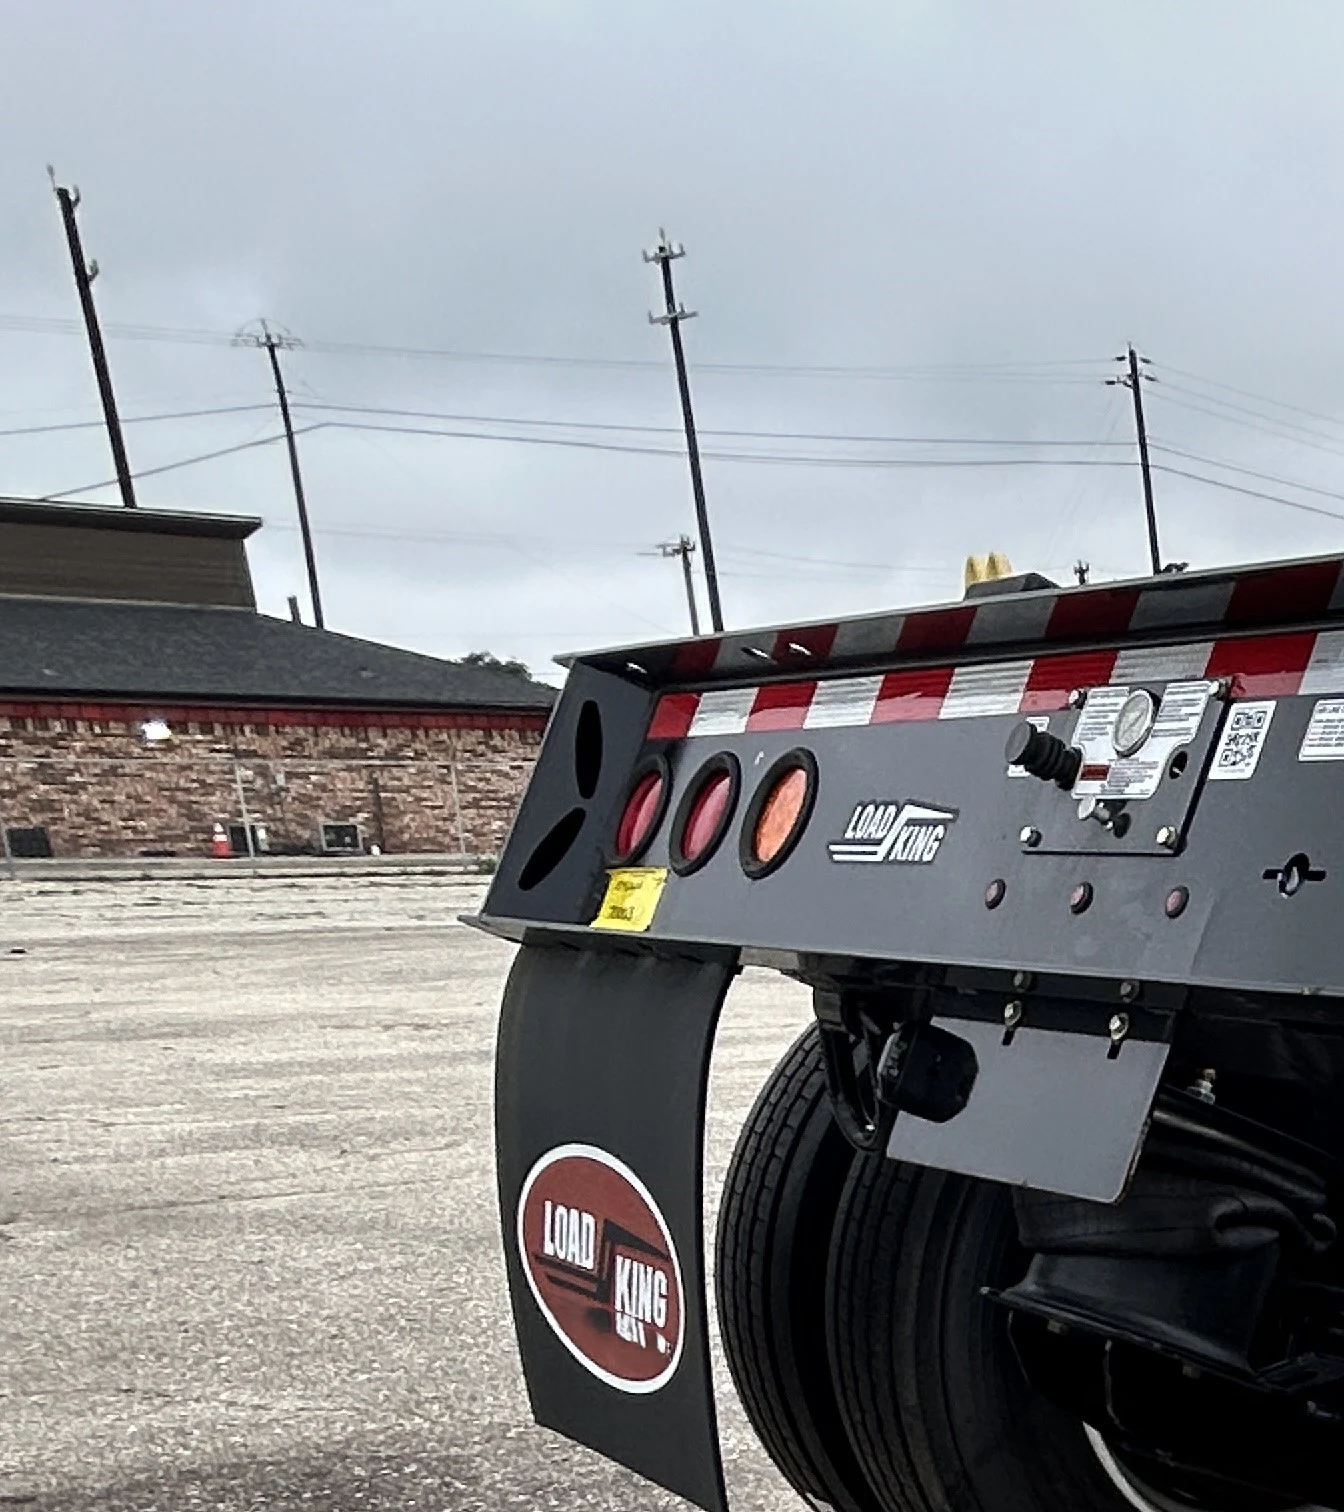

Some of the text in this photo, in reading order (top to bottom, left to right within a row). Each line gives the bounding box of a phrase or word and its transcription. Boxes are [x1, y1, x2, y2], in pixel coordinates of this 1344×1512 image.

[844, 804, 899, 840] LOAD
[888, 824, 946, 862] KING
[543, 1200, 597, 1271] LOAD
[614, 1254, 669, 1328] KING
